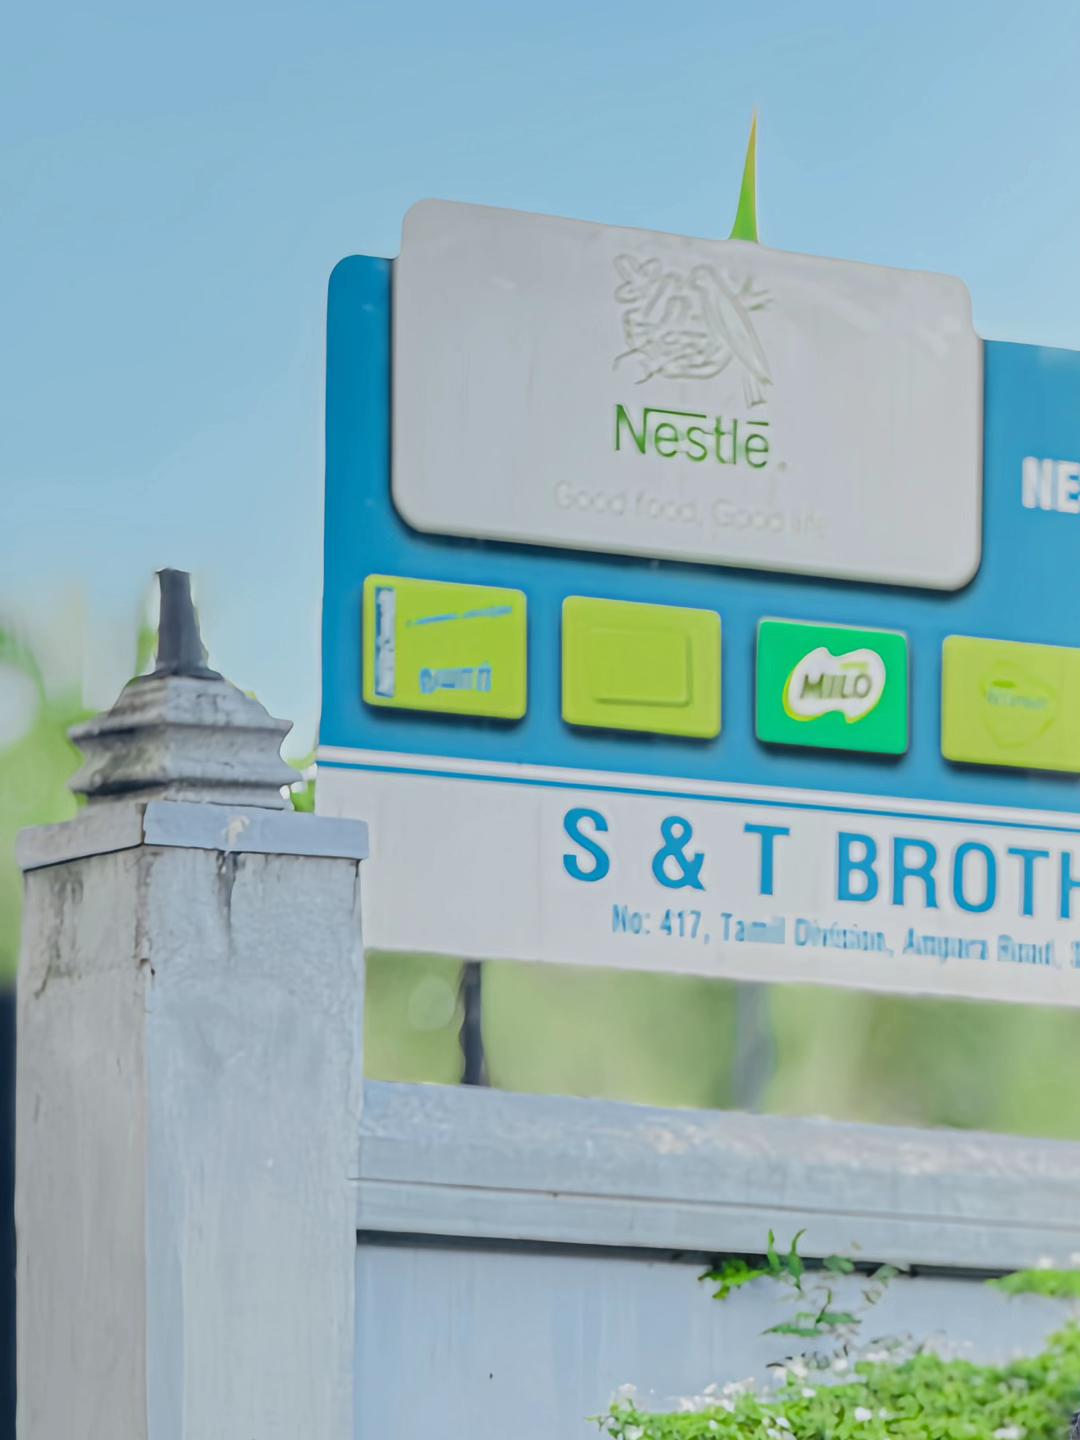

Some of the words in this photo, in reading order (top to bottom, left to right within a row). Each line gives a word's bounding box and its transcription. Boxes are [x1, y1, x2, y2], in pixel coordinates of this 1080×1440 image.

[800, 673, 874, 700] MILO
[562, 807, 610, 882] S
[651, 815, 706, 892] &
[743, 822, 791, 896] T
